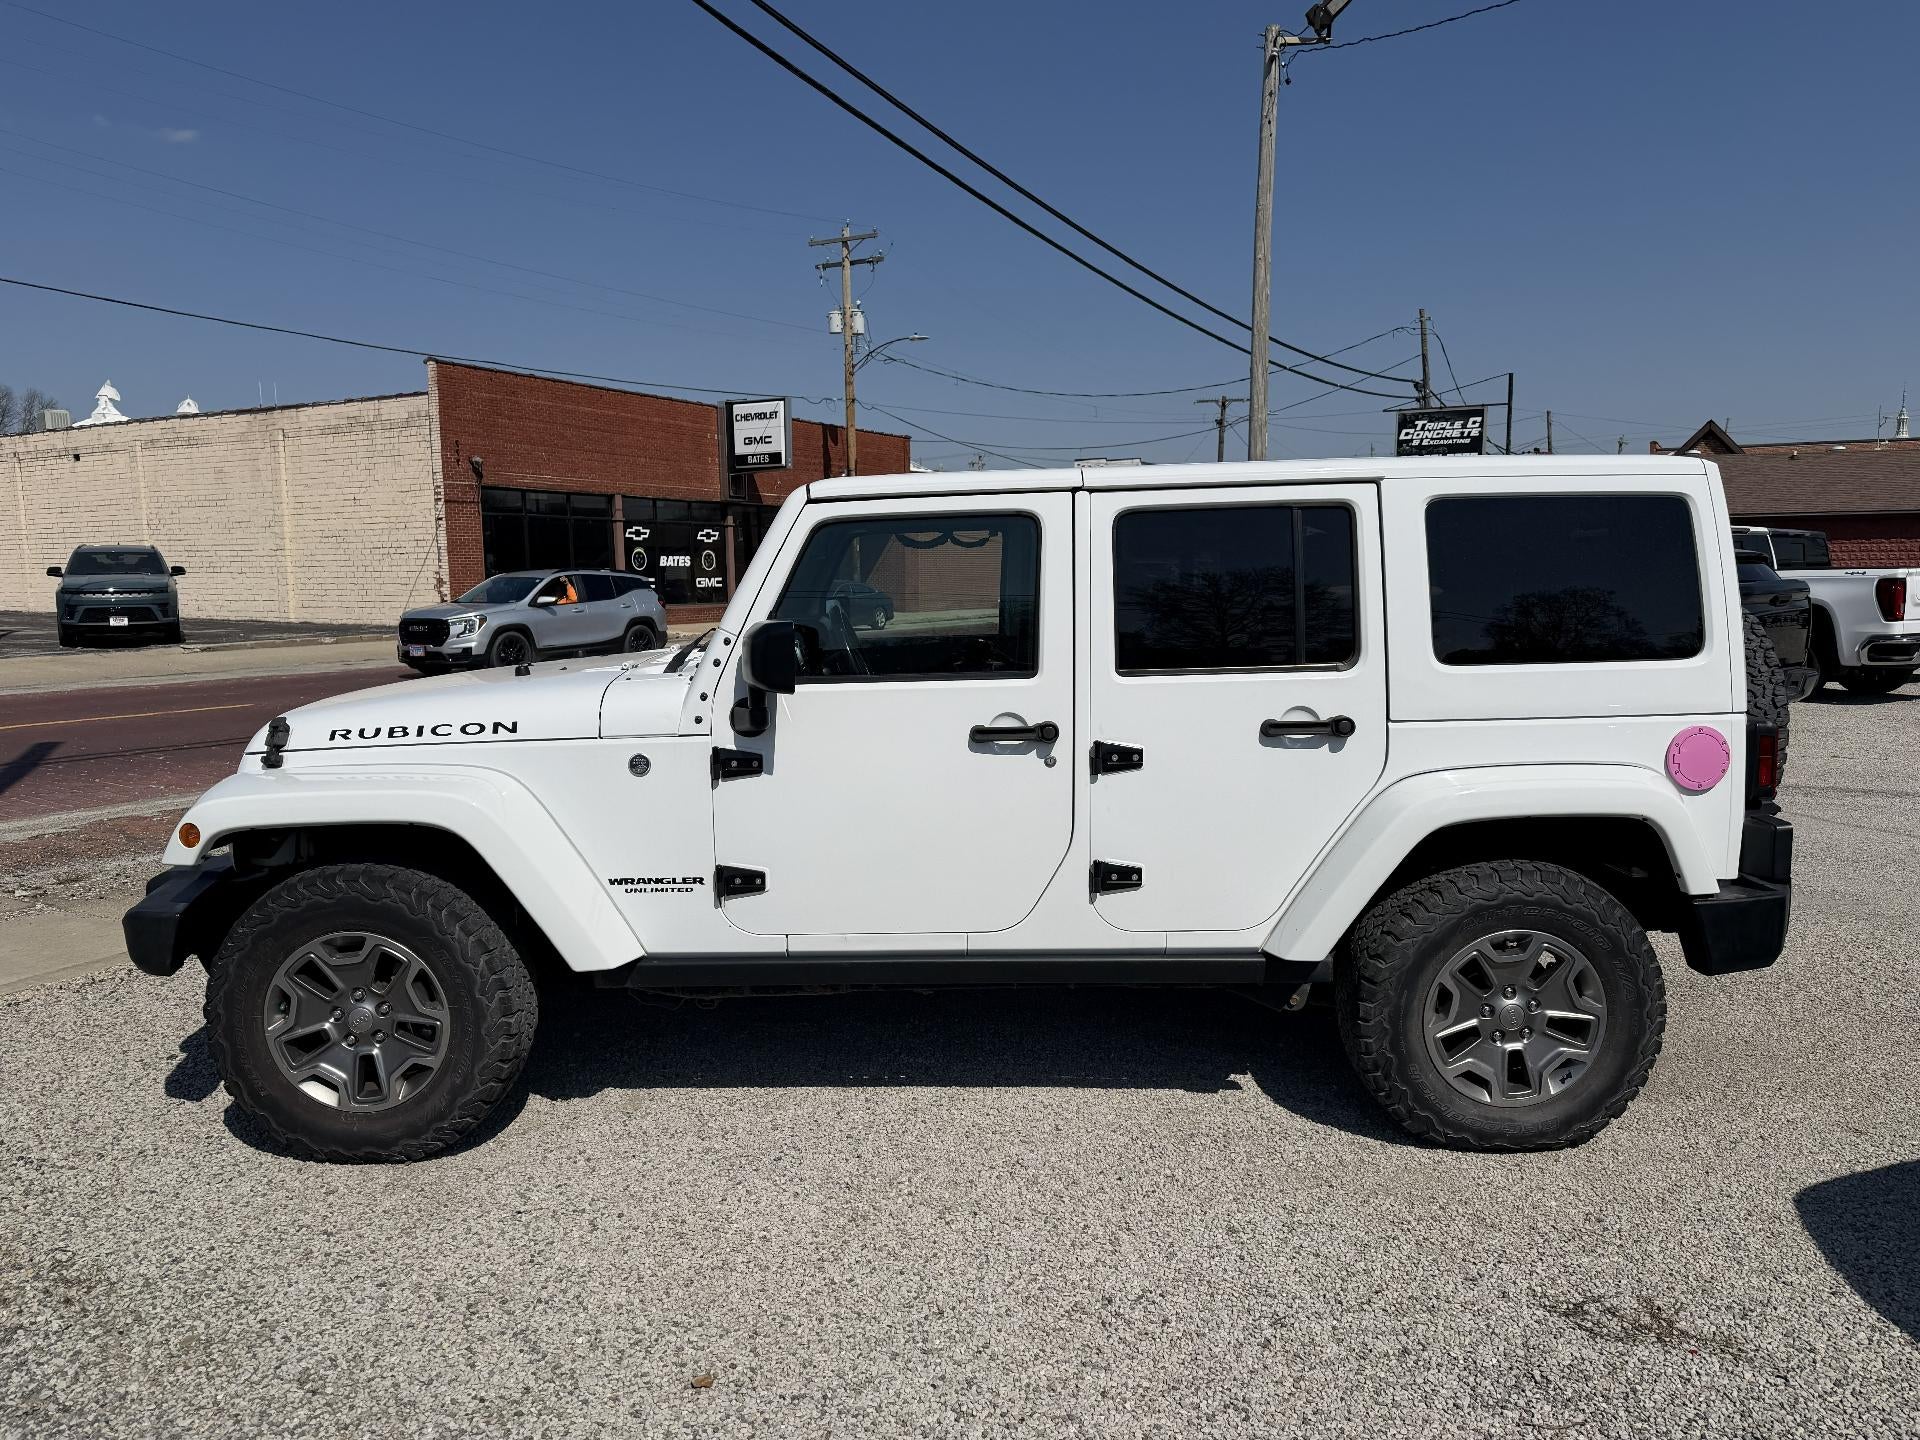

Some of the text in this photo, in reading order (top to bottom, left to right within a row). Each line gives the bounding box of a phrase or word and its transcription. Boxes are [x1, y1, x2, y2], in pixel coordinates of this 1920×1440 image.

[735, 411, 778, 422] CHEVROLET
[1415, 417, 1482, 430] TRIPLE C
[1399, 428, 1481, 440] CONCRETE
[744, 436, 772, 445] GMC
[747, 455, 769, 463] BATES
[660, 556, 691, 567] BATES
[696, 578, 722, 587] GMC
[329, 721, 518, 741] RUBICON
[608, 877, 706, 886] WRANGLER
